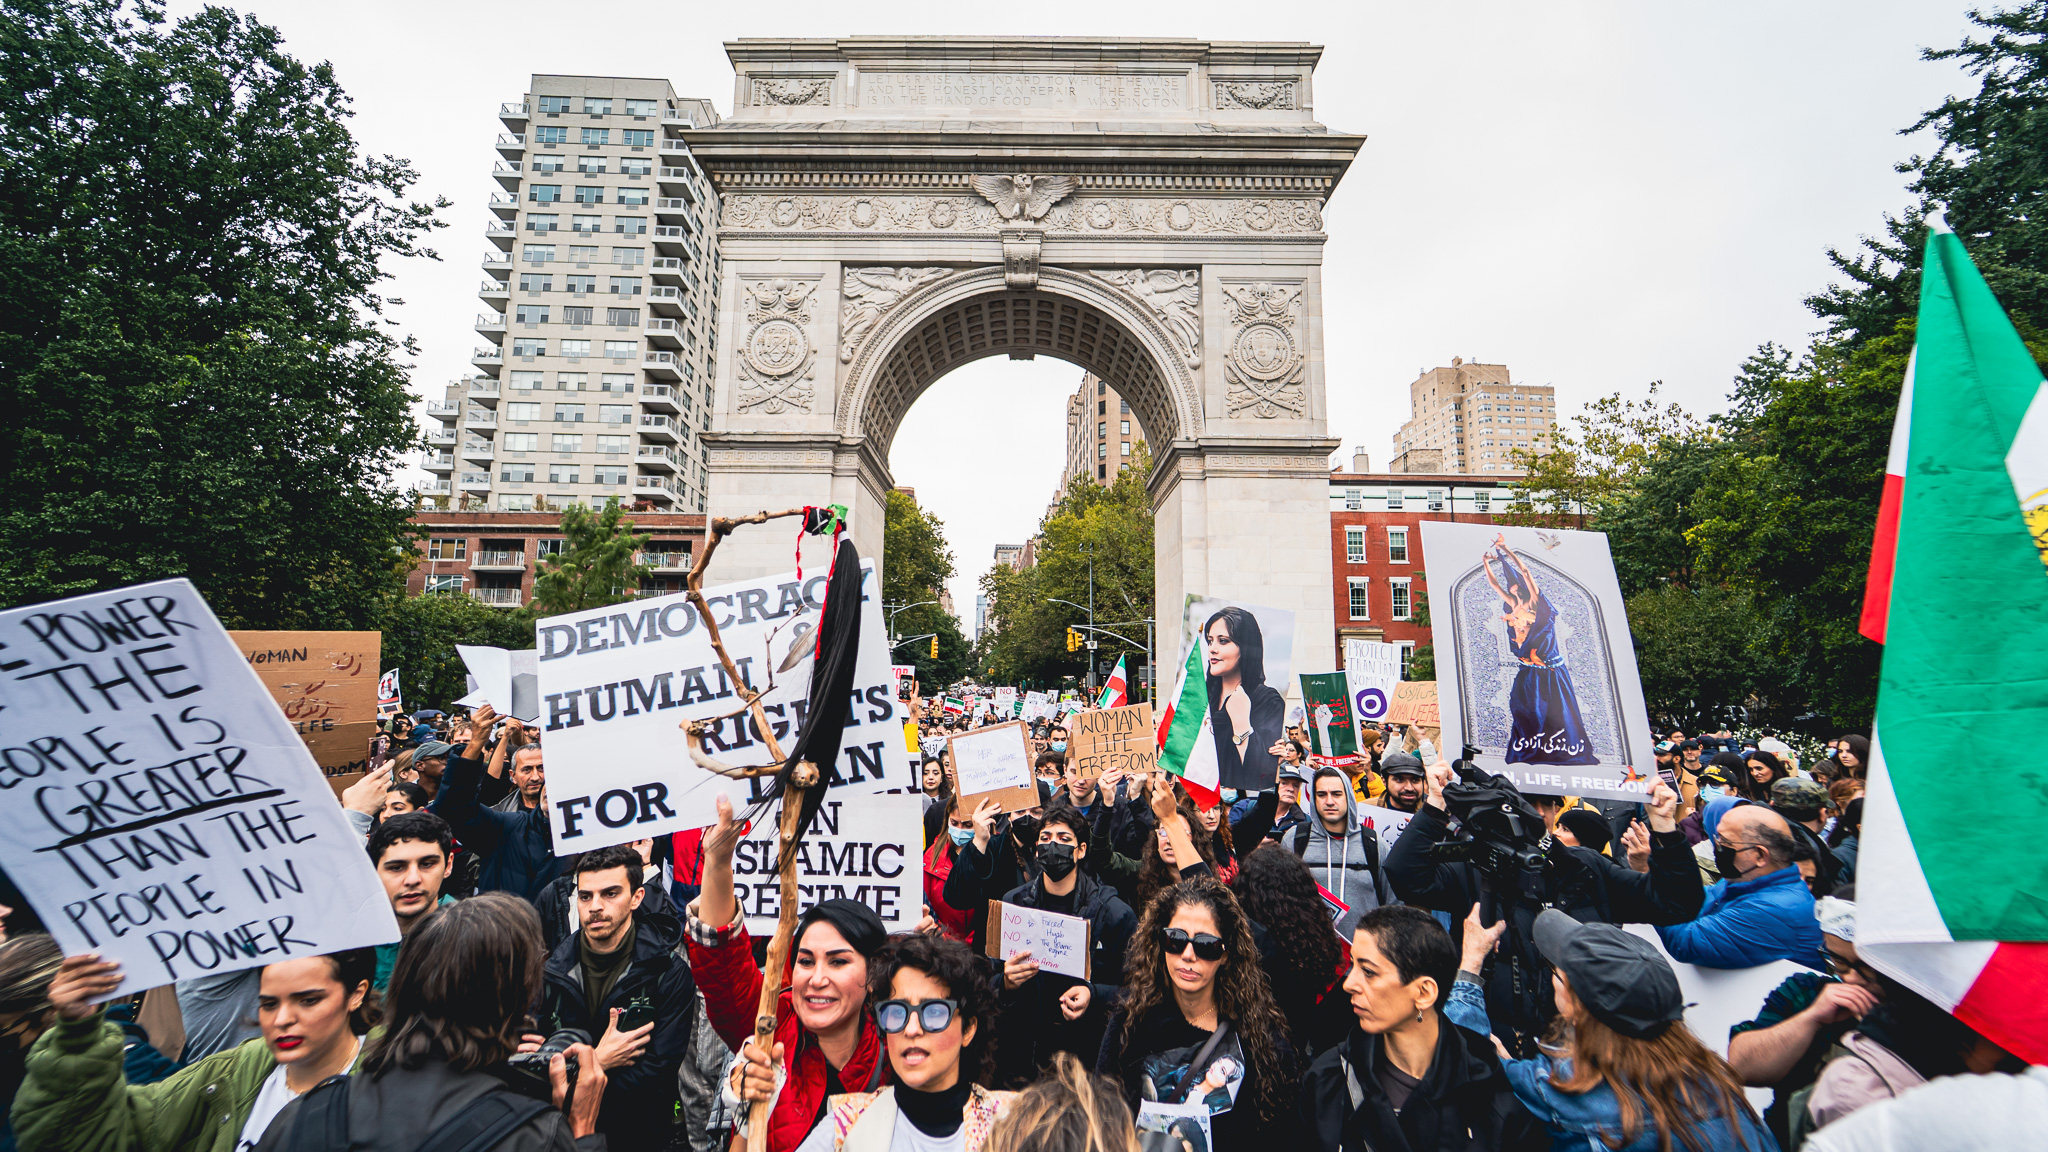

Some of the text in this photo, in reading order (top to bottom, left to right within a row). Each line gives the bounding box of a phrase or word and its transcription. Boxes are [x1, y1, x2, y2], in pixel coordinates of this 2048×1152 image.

[868, 75, 1178, 87] LET US RAISE A STANDARD TO WHICH THE WISE
[868, 86, 1179, 97] AND THE HONEST CAN REPAIR THE EVENT
[867, 96, 1031, 106] IS IN THE HAND OF GOD
[1088, 98, 1179, 107] WASHINGTON
[20, 595, 200, 662] POWER
[1348, 639, 1394, 661] PROTECT
[14, 643, 203, 714] THE
[545, 657, 753, 731] HUMAN
[151, 706, 226, 751] IS
[298, 718, 334, 735] IFE
[699, 684, 893, 754] RIGTS
[1080, 707, 1143, 735] WOMAN
[1093, 732, 1132, 754] LIFE
[1079, 752, 1156, 777] FREEDOM
[1524, 772, 1567, 790] LIFE,
[33, 745, 275, 837] GREATER
[557, 782, 676, 840] FOR
[34, 800, 317, 889] THAN THE
[733, 838, 905, 879] SLAMIC
[63, 858, 304, 949] PEOPLE IN
[1003, 931, 1021, 942] NO
[1004, 912, 1022, 925] NO
[1042, 916, 1064, 929] Forced
[147, 915, 317, 979] POWER
[1512, 955, 1520, 994] GITZO
